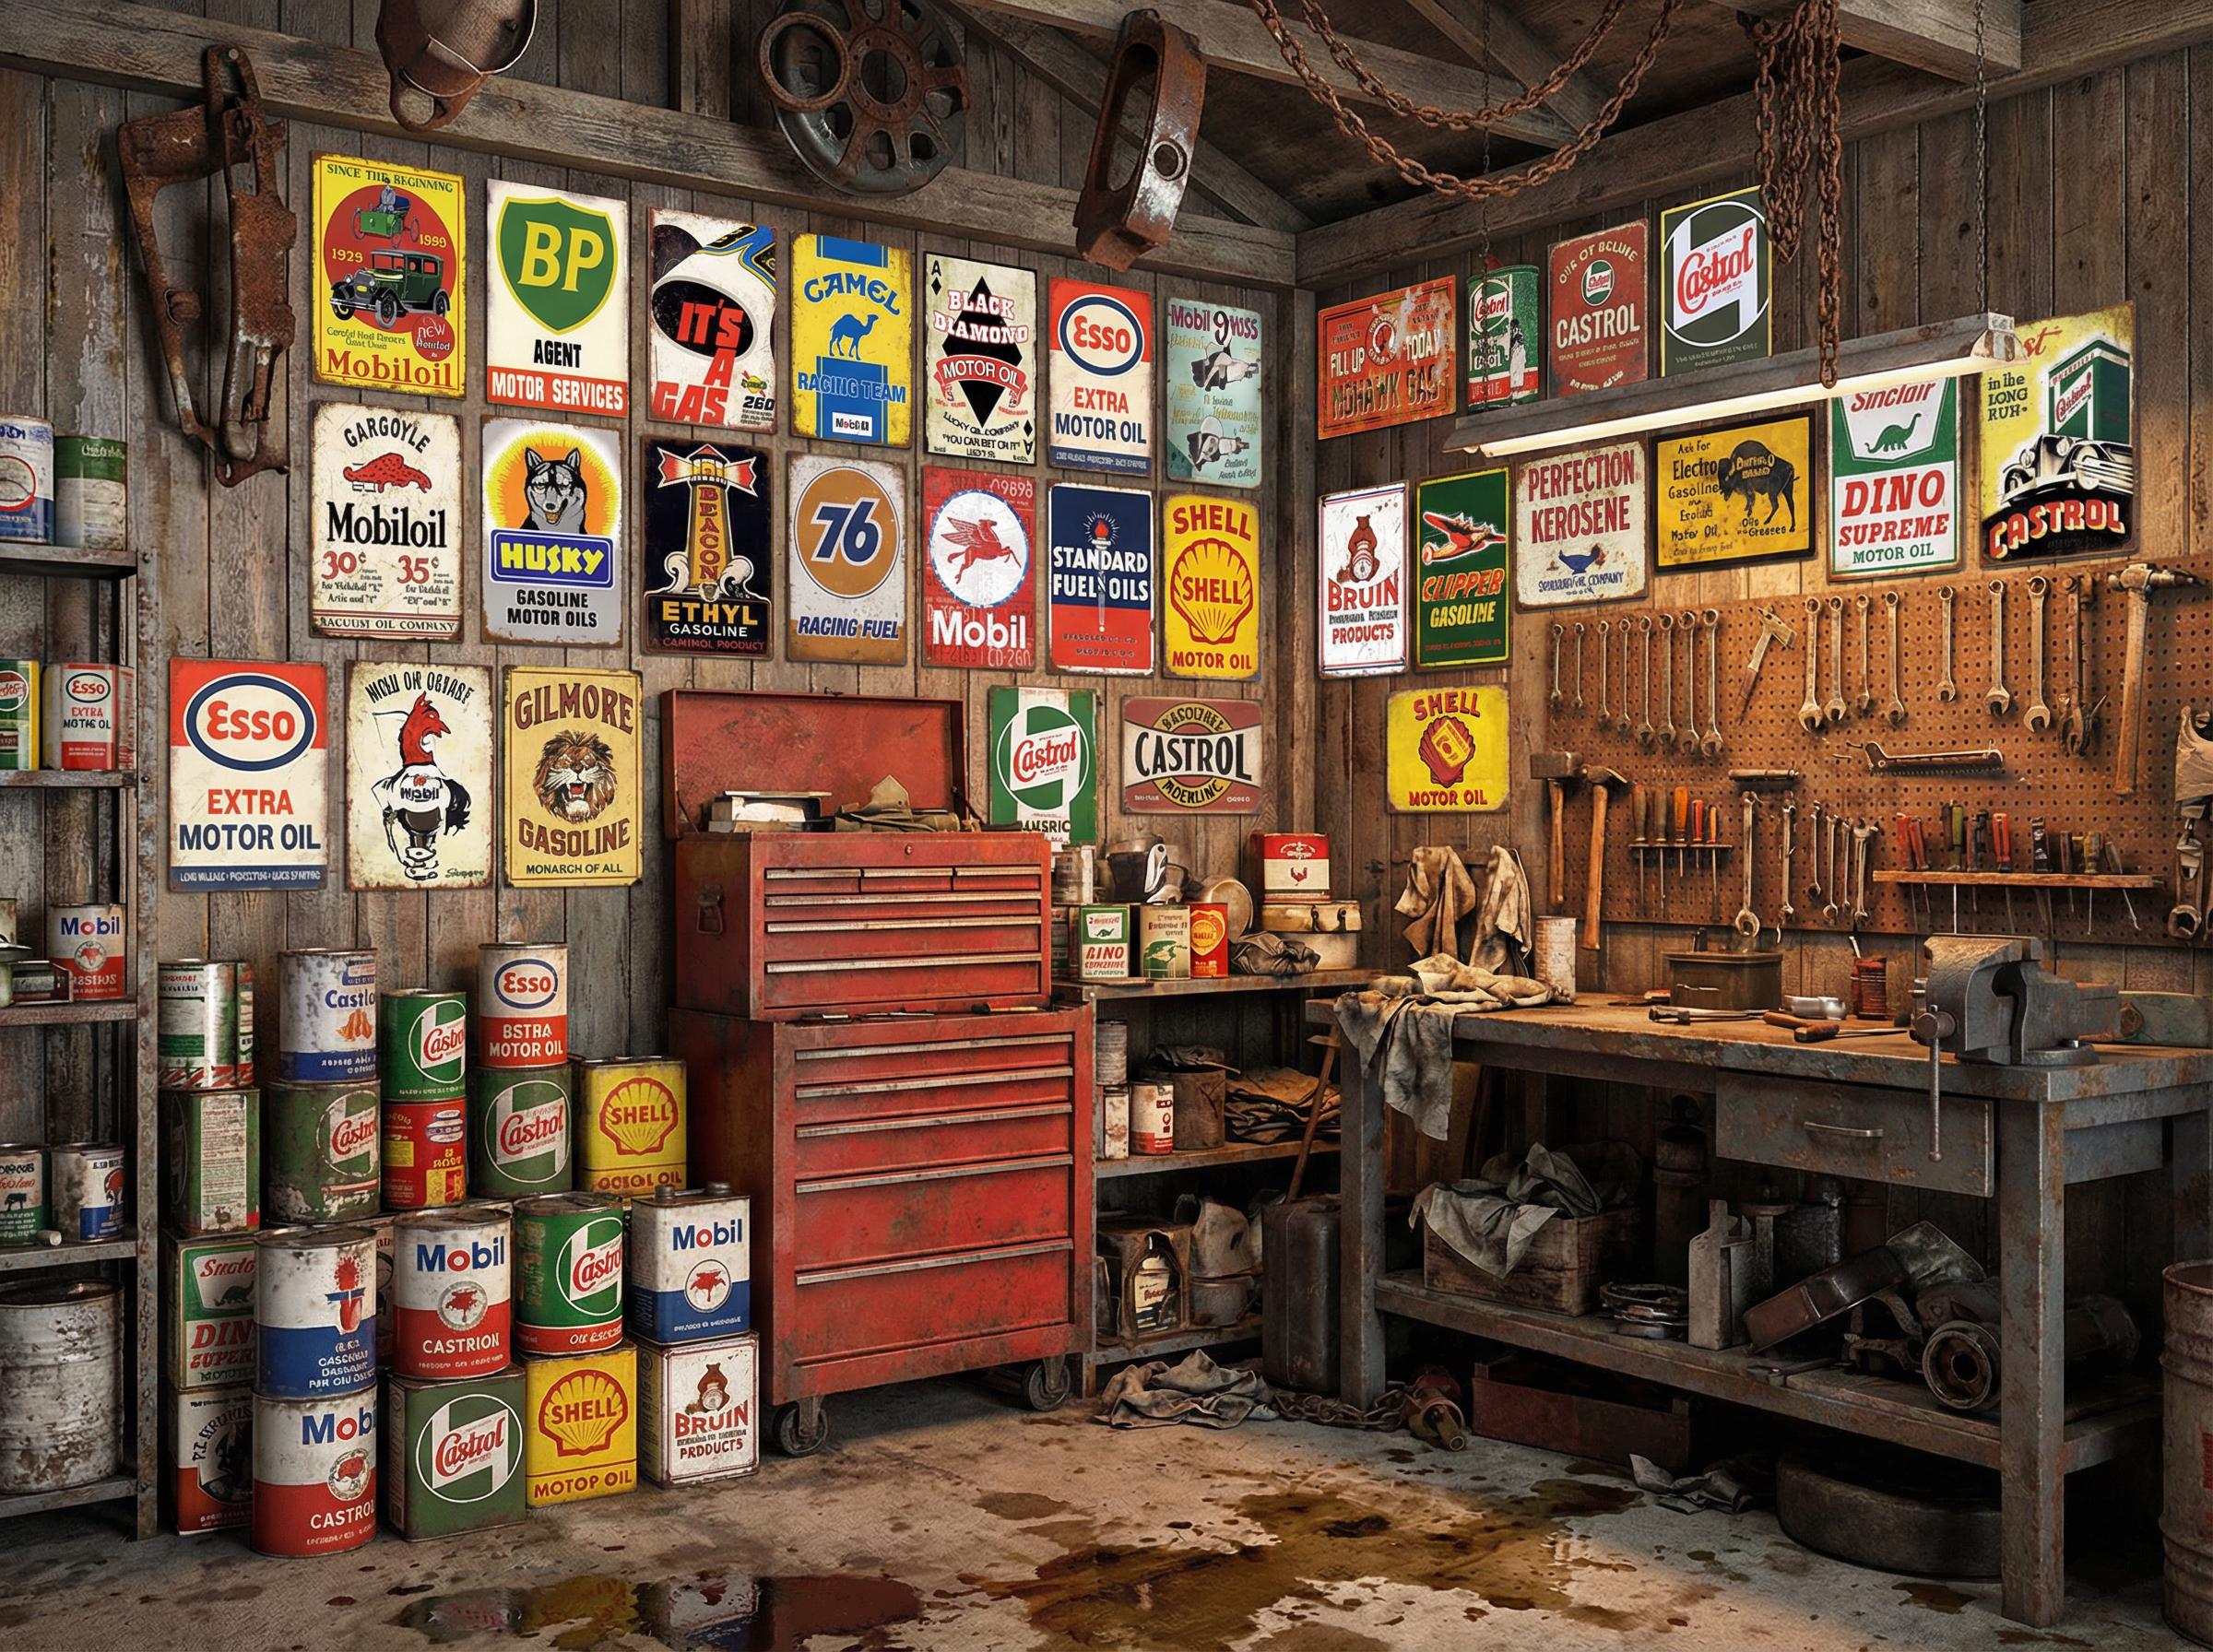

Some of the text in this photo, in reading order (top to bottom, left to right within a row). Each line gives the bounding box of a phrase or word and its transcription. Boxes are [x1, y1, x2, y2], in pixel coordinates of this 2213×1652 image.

[327, 163, 361, 178] SINCE
[332, 247, 363, 263] 1929
[517, 221, 605, 292] BP
[931, 260, 941, 277] A
[1677, 227, 1754, 314] Castrol
[804, 272, 900, 315] CAMEL
[948, 289, 1014, 320] BLACK
[676, 299, 744, 348] IT'S
[933, 310, 1028, 344] DIAMOND
[1171, 304, 1211, 332] Mobil
[1556, 302, 1641, 349] CASTROL
[534, 339, 582, 368] AGENT
[1405, 328, 1441, 361] TODAY
[326, 348, 452, 387] Mobiloil
[704, 347, 737, 387] A
[942, 360, 1021, 389] MOTOR OIL
[1352, 347, 1365, 373] UP
[491, 372, 623, 410] MOTOR SERVICES
[798, 372, 906, 403] RACING TEAM
[1851, 382, 1936, 413] Sinclair
[1988, 378, 2001, 391] in
[1988, 387, 2029, 407] LONG
[653, 381, 728, 424] GAS
[742, 395, 775, 411] 260
[1074, 387, 1130, 414] EXTRA
[344, 416, 431, 454] GARGOYLE
[1056, 413, 1147, 444] MOTOR OIL
[1023, 439, 1034, 455] A
[1697, 440, 1710, 451] For
[1529, 450, 1635, 502] PERFECTION
[1674, 458, 1718, 480] Electro
[1841, 469, 1946, 518] DINO
[326, 502, 447, 549] Mobiloil
[699, 486, 721, 580] BEACON
[811, 497, 882, 566] 76
[1172, 504, 1252, 542] SHELL
[1532, 495, 1630, 544] KEROSENE
[1839, 513, 1950, 547] SUPREME
[1989, 499, 2125, 560] CASTROL
[501, 542, 605, 575] HUSKY
[1053, 547, 1149, 573] STANDARD
[1852, 542, 1935, 564] MOTOR OIL
[516, 589, 588, 609] GASOLINE
[1053, 574, 1149, 602] FUEL OILS
[1181, 576, 1243, 606] SHELL
[1328, 567, 1399, 611] BRUIN
[1422, 568, 1506, 602] CLIPPER
[375, 619, 396, 630] OIL
[507, 608, 598, 629] MOTOR OILS
[662, 601, 759, 626] ETHYL
[798, 616, 899, 640] RACING FUEL
[1430, 601, 1497, 628] GASOLINE
[669, 623, 748, 637] GASOLINE
[933, 609, 1026, 649] Mobil
[1332, 623, 1394, 644] PRODUCTS
[1172, 651, 1252, 670] MOTOR OIL
[71, 707, 103, 717] EXTRA
[515, 682, 634, 735] GILMORE
[1013, 730, 1077, 783] Castrol
[1135, 731, 1252, 781] CASTROL
[207, 789, 294, 815] EXTRA
[1408, 789, 1488, 807] MOTOR OIL
[179, 824, 321, 851] MOTOR OIL
[518, 818, 631, 857] GASOLINE
[526, 862, 623, 875] MONARCH OF ALL
[61, 916, 120, 936] Mobil
[489, 1040, 563, 1057] MOTOR OIL
[501, 1104, 563, 1155] Castrol
[611, 1104, 670, 1126] SHELL
[657, 1172, 682, 1185] OIL
[672, 1219, 742, 1252] Mobil
[417, 1235, 505, 1273] Mobil
[191, 1318, 256, 1351] DIN
[422, 1332, 500, 1354] CASTRION
[551, 1396, 618, 1425] SHELL
[675, 1399, 749, 1439] BRUIN
[435, 1416, 505, 1478] Castrol
[604, 1469, 633, 1487] OIL
